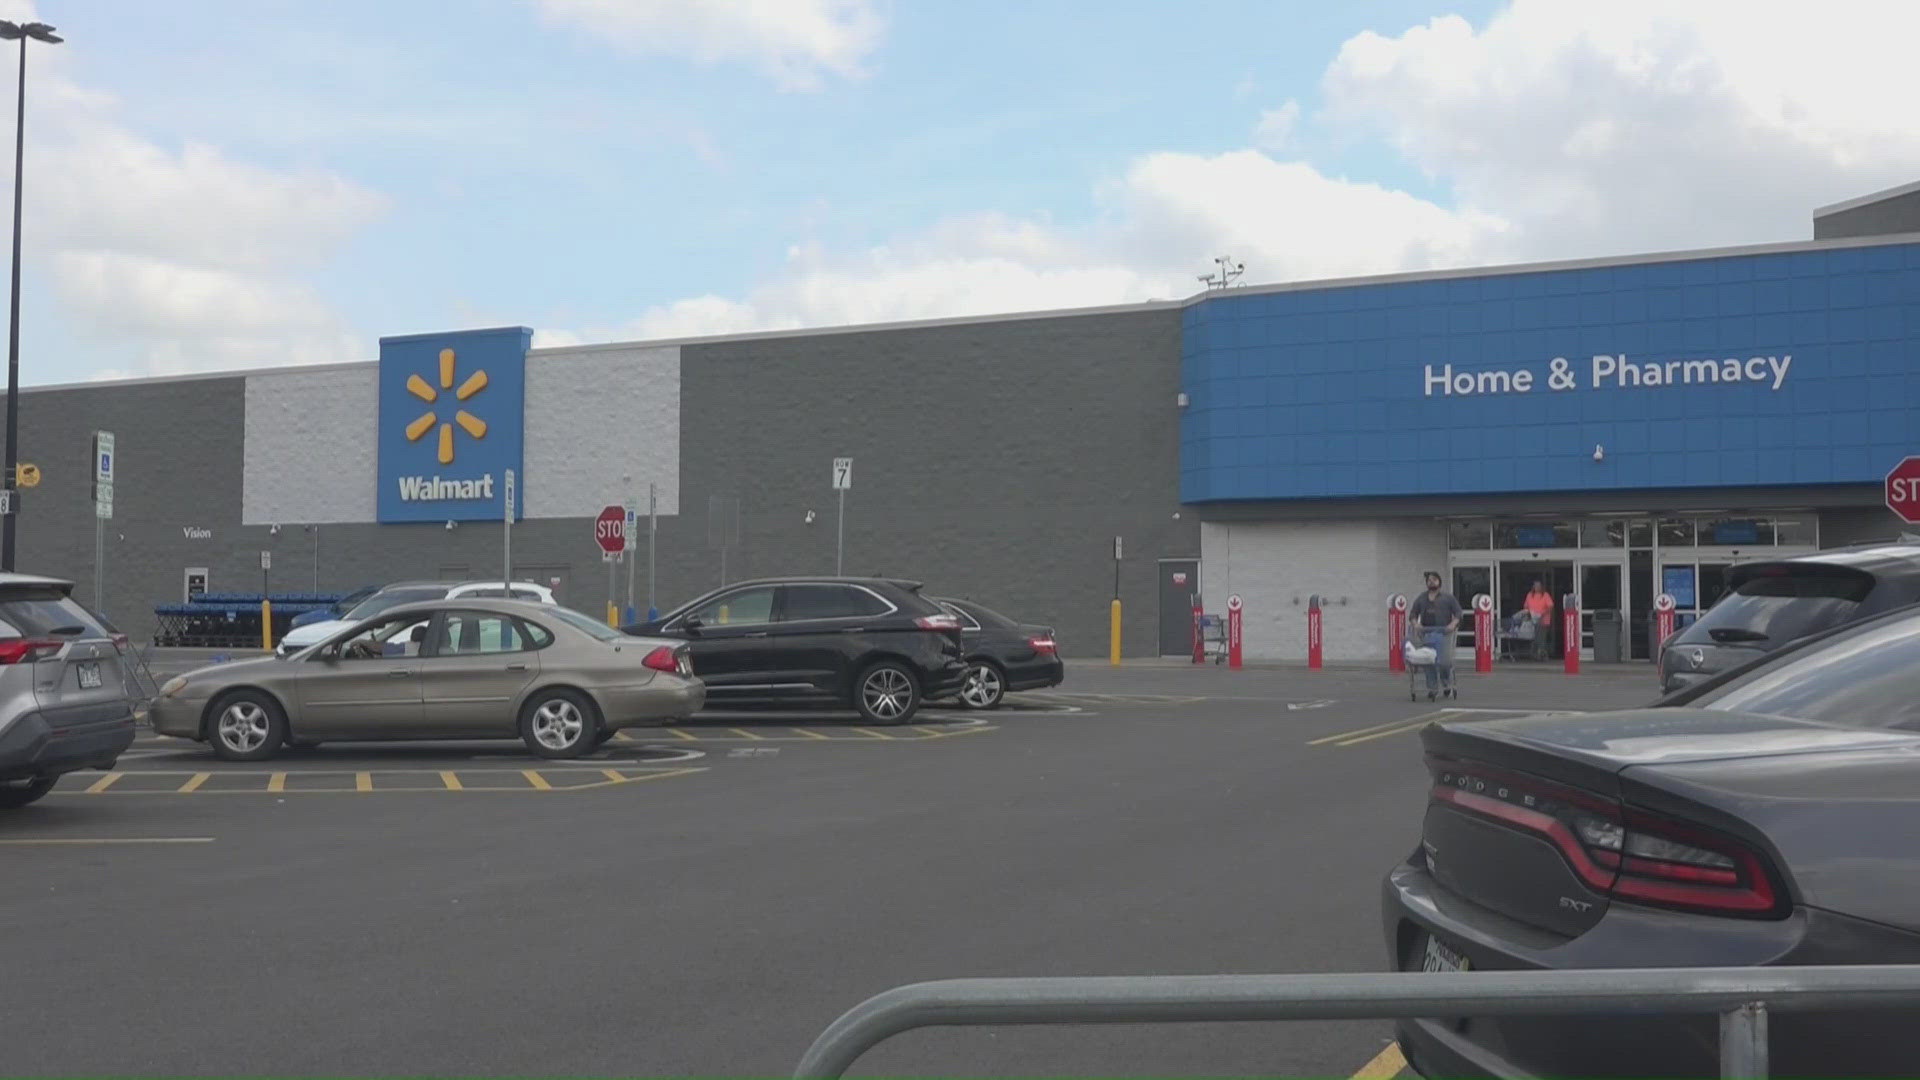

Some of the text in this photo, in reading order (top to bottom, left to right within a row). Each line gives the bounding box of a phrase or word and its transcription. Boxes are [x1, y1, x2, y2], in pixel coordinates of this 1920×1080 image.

[1425, 353, 1792, 395] Home & Pharmacy
[399, 474, 493, 501] Walmart
[838, 469, 847, 486] 7
[1891, 478, 1920, 502] ST
[183, 527, 211, 539] Vision
[1444, 774, 1535, 806] DODGE
[1559, 896, 1592, 912] SXT
